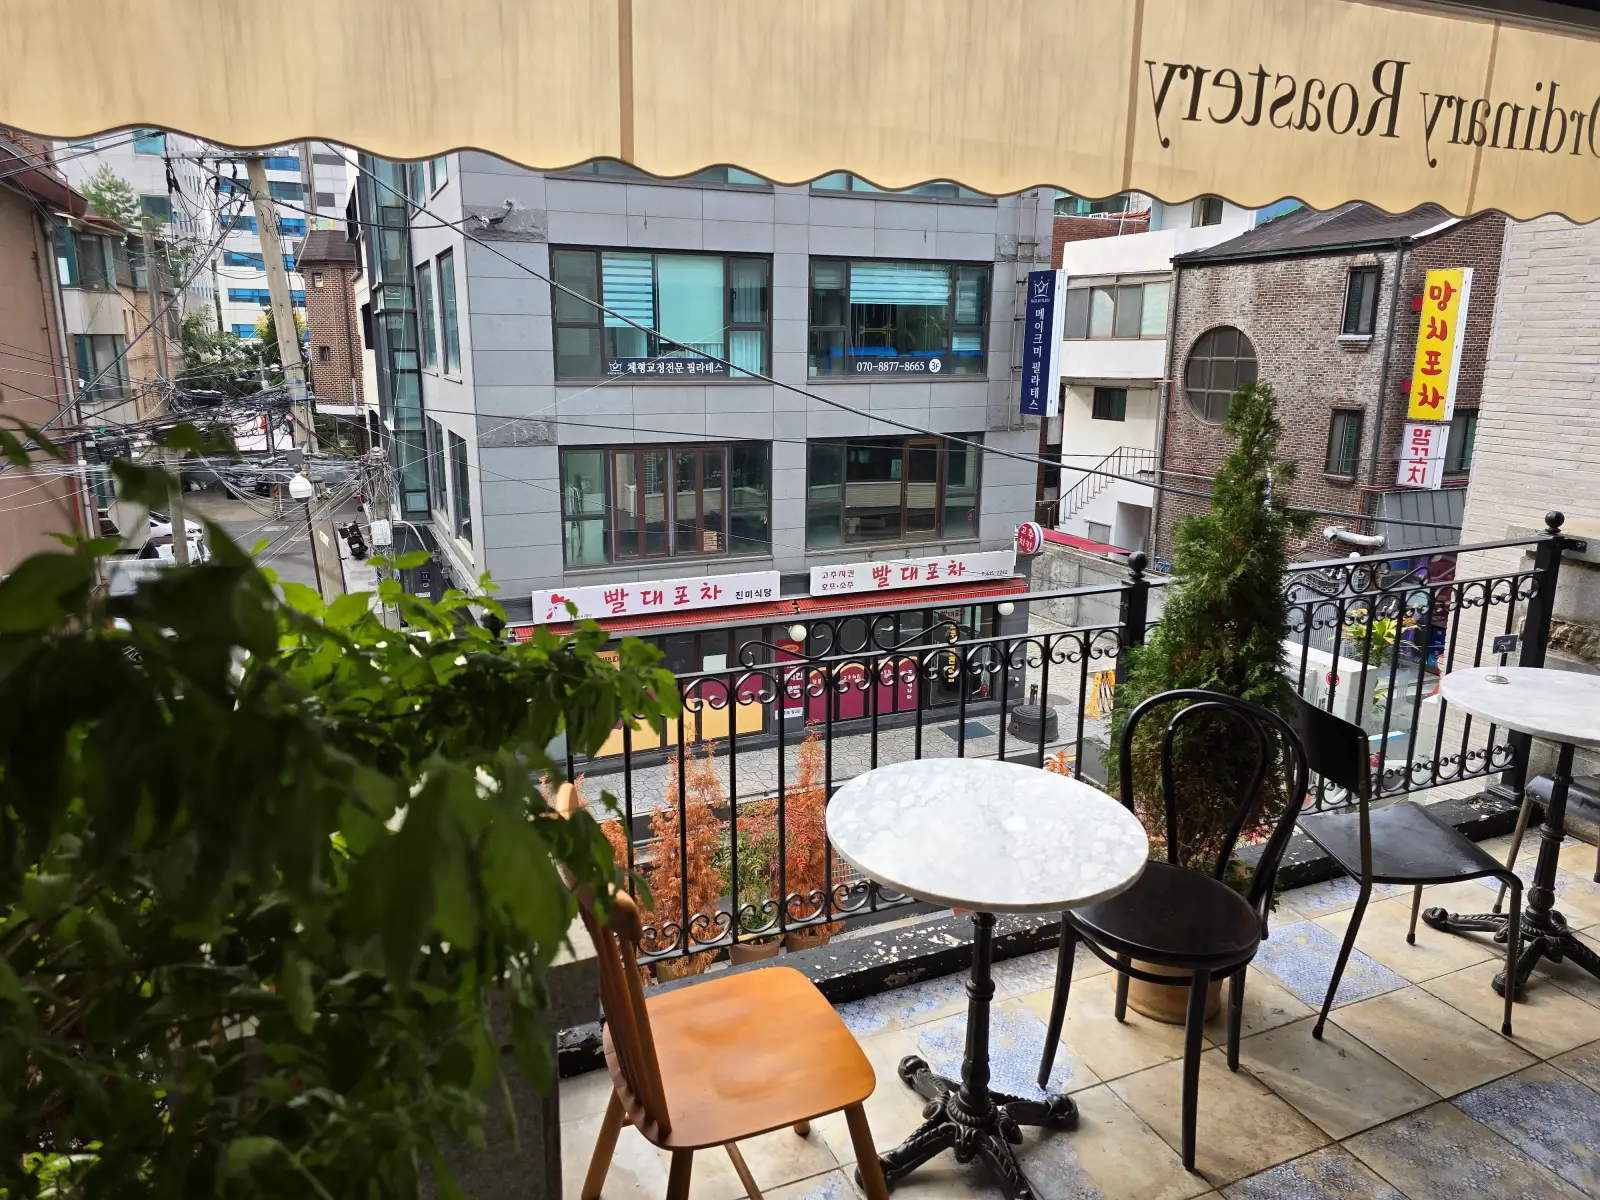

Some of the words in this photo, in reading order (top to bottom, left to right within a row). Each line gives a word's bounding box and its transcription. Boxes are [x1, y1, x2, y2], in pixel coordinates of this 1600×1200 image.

[1032, 307, 1045, 358] 메이크미
[1418, 280, 1457, 409] 망치포차
[627, 361, 685, 374] 체형교정전문
[686, 361, 724, 374] 필라테스
[856, 361, 925, 372] 070-8877-8665
[1028, 361, 1041, 410] 필라테스
[1020, 525, 1035, 540] 고추
[1019, 536, 1033, 552] 치킨
[872, 559, 966, 588] 빨대포차
[603, 582, 723, 615] 빨대포차
[735, 588, 773, 600] 진미식당
